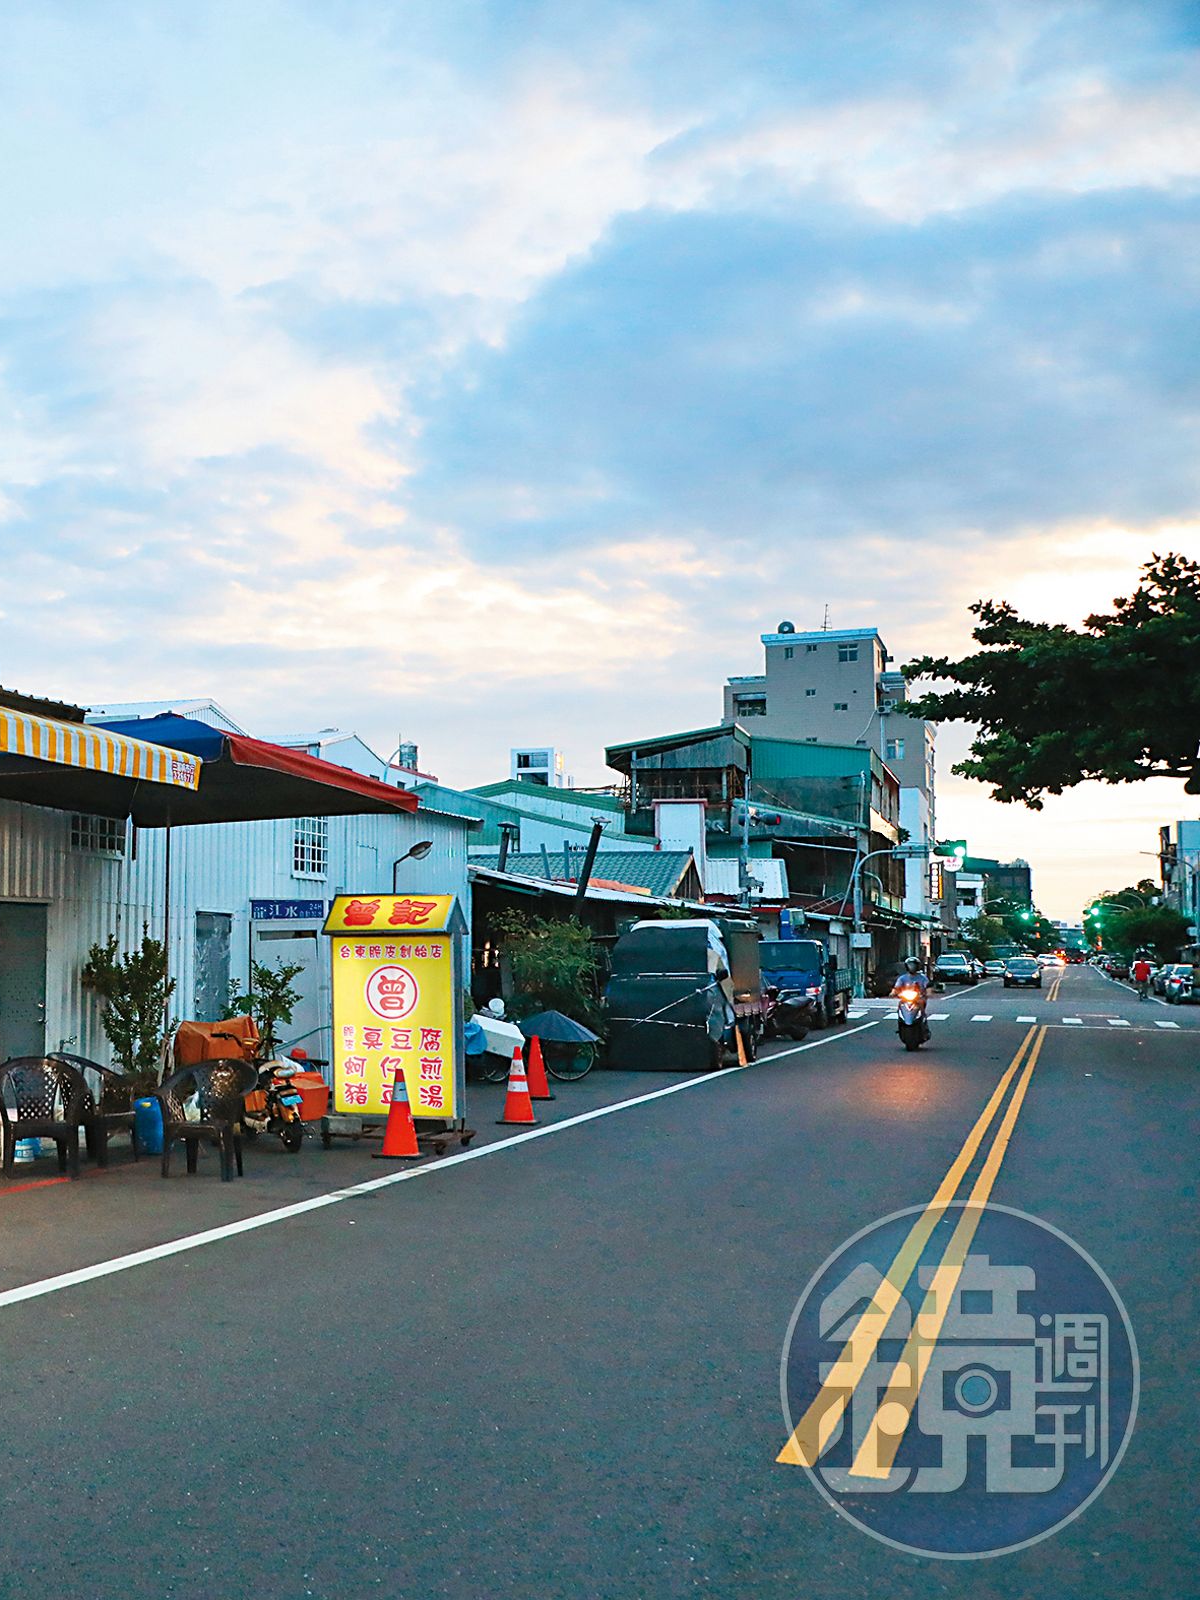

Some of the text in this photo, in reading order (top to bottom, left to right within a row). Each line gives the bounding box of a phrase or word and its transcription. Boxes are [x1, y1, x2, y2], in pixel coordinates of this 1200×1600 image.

[343, 898, 438, 927] 曾記
[340, 944, 443, 959] 台東脆皮創始店
[377, 974, 406, 1011] 曾
[361, 1026, 443, 1052] 臭豆腐
[344, 1056, 443, 1080] 蚵仔煎
